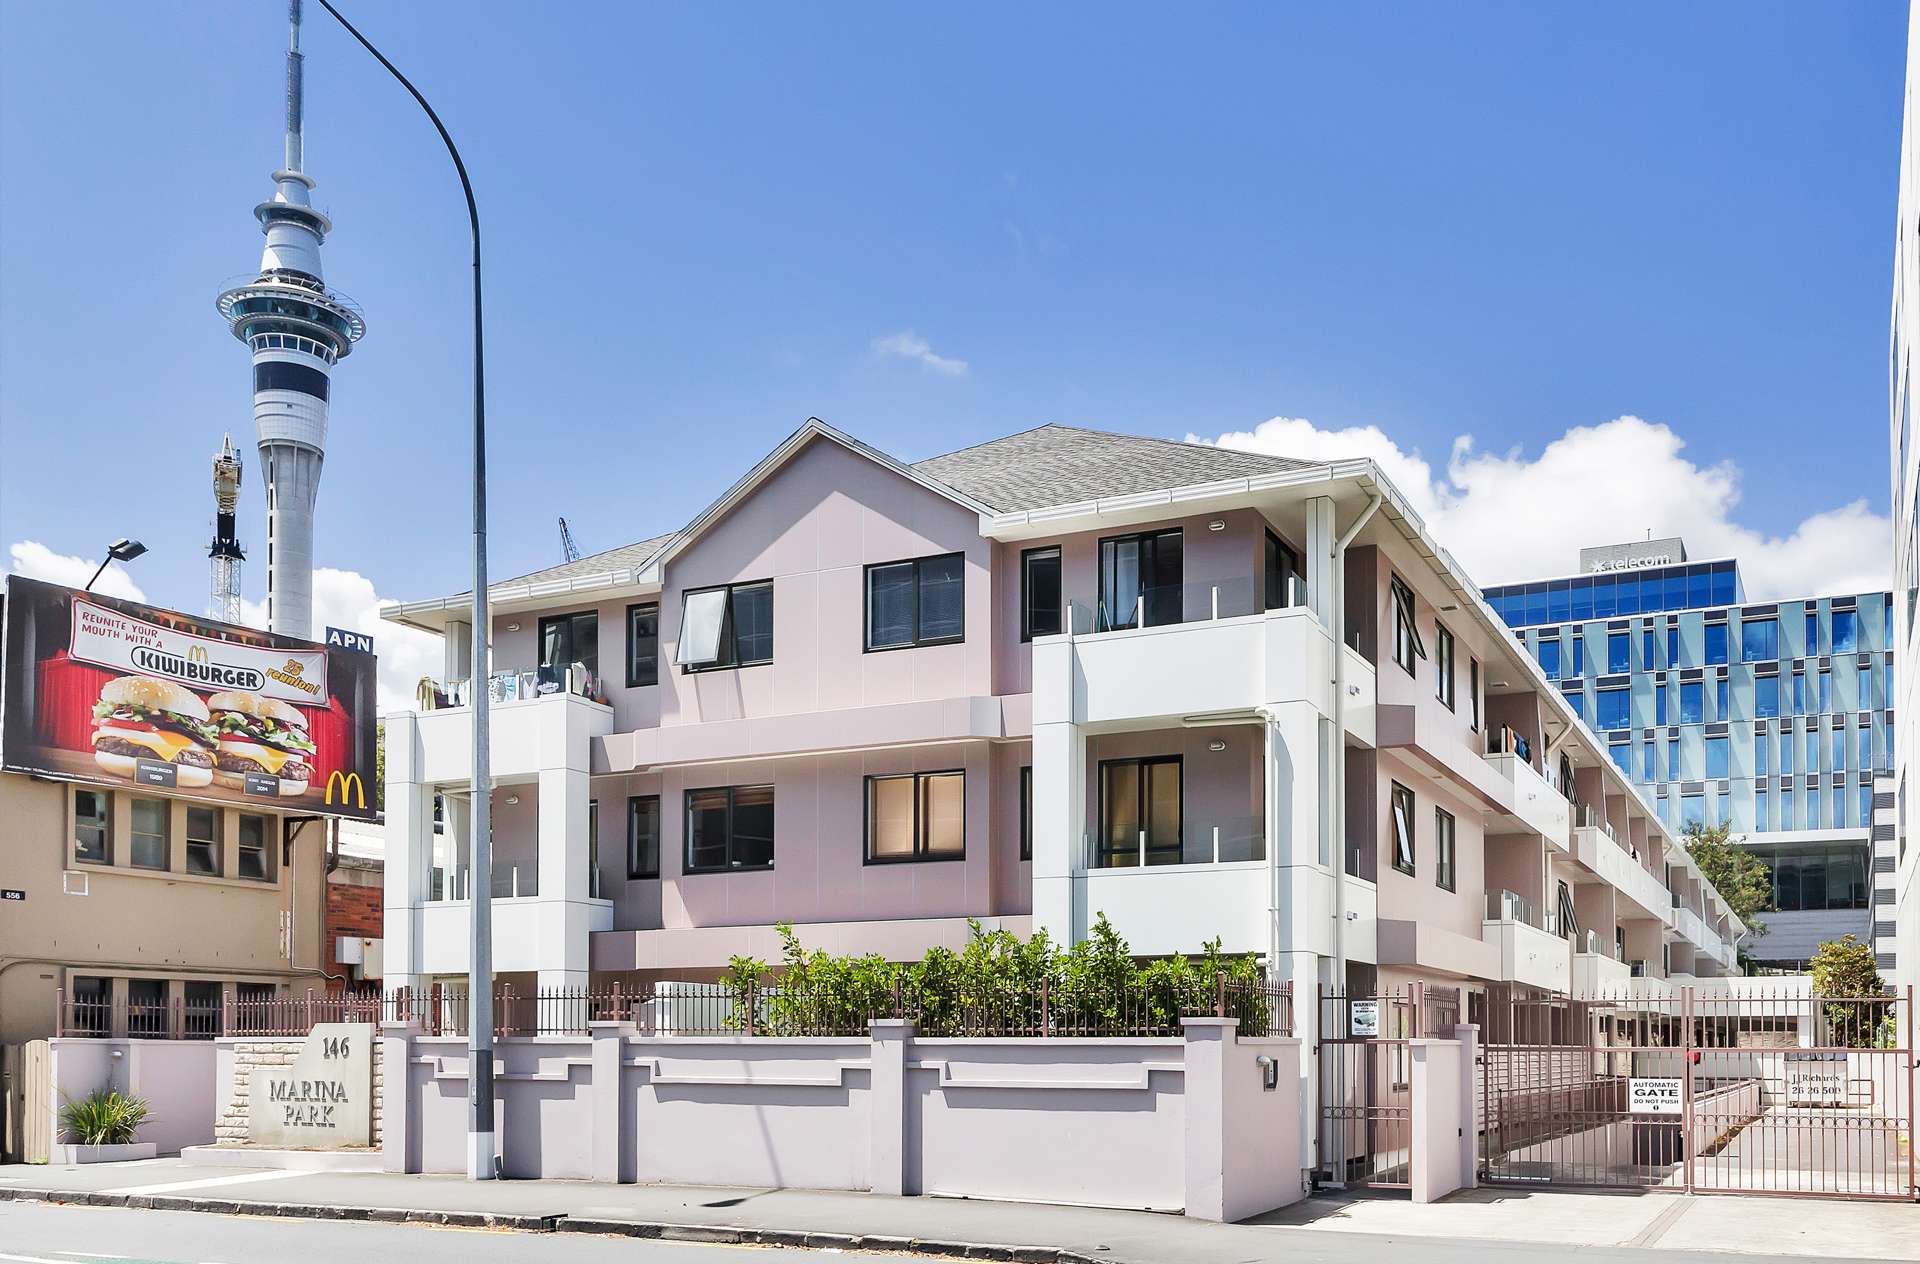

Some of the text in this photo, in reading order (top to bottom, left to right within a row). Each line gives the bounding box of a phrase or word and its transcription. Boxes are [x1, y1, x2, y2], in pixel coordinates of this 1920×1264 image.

[1610, 553, 1671, 570] telecom
[81, 623, 163, 649] MOUTH WITH A
[82, 611, 158, 638] REUNITE YOUR
[328, 630, 370, 652] APN
[139, 650, 259, 688] KIWIBURGER
[323, 1036, 350, 1059] 146
[1802, 1073, 1840, 1082] Rchards
[270, 1079, 349, 1102] MARINA
[1634, 1089, 1679, 1097] GATE
[283, 1105, 336, 1128] PARK
